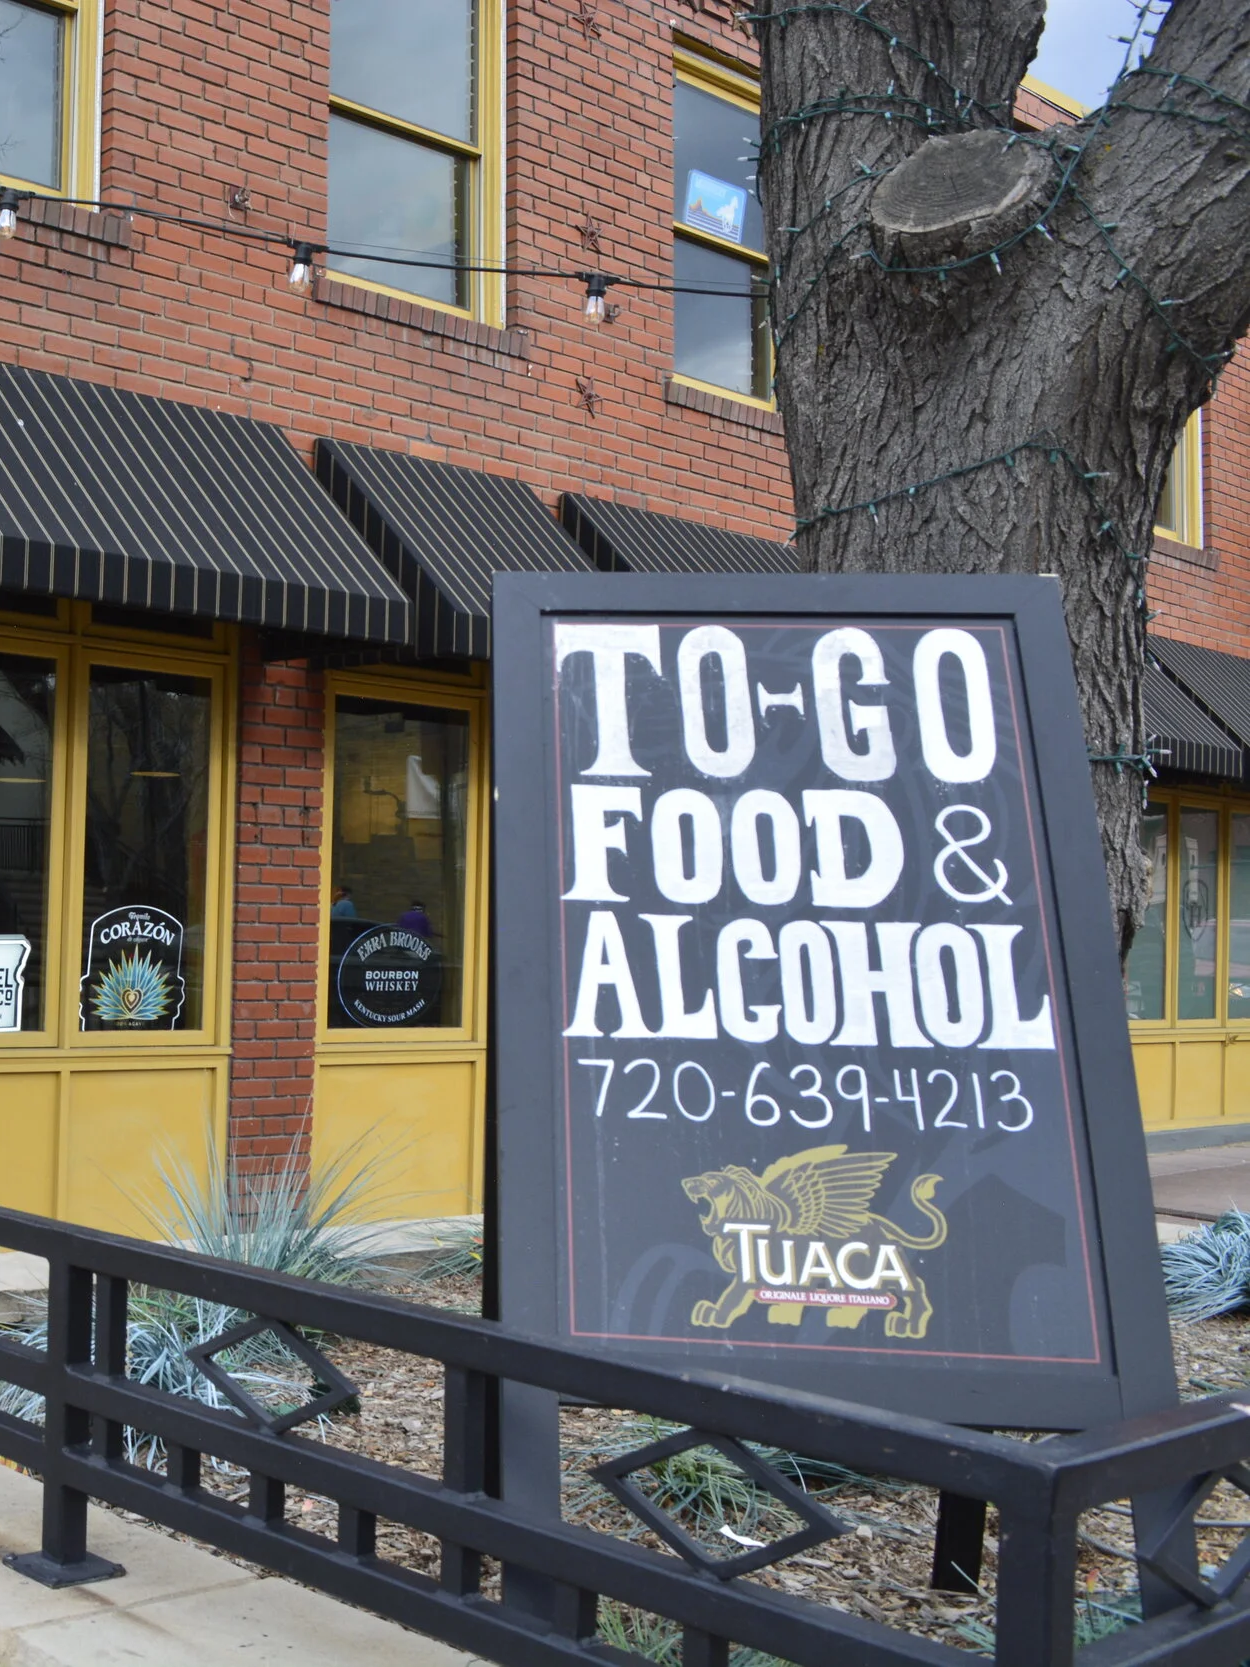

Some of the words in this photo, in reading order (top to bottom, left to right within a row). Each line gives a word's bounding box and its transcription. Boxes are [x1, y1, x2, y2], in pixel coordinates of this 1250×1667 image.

[560, 784, 904, 908] FOOD
[934, 804, 1013, 905] &
[100, 920, 176, 946] CORAZÓN
[389, 931, 432, 961] BROOKS
[365, 970, 419, 980] BOURBON
[365, 981, 419, 991] WHISKEY
[562, 910, 1056, 1050] ALCOHOL
[353, 999, 387, 1022] KENTUCKY
[387, 1013, 406, 1022] SOUR
[406, 999, 426, 1018] MASH
[577, 1058, 1034, 1132] 720-639-4213
[723, 1222, 912, 1291] TUACA
[760, 1290, 807, 1302] ORIGINALE
[809, 1292, 847, 1304] LIQUORE
[849, 1294, 890, 1305] ITALIANO
